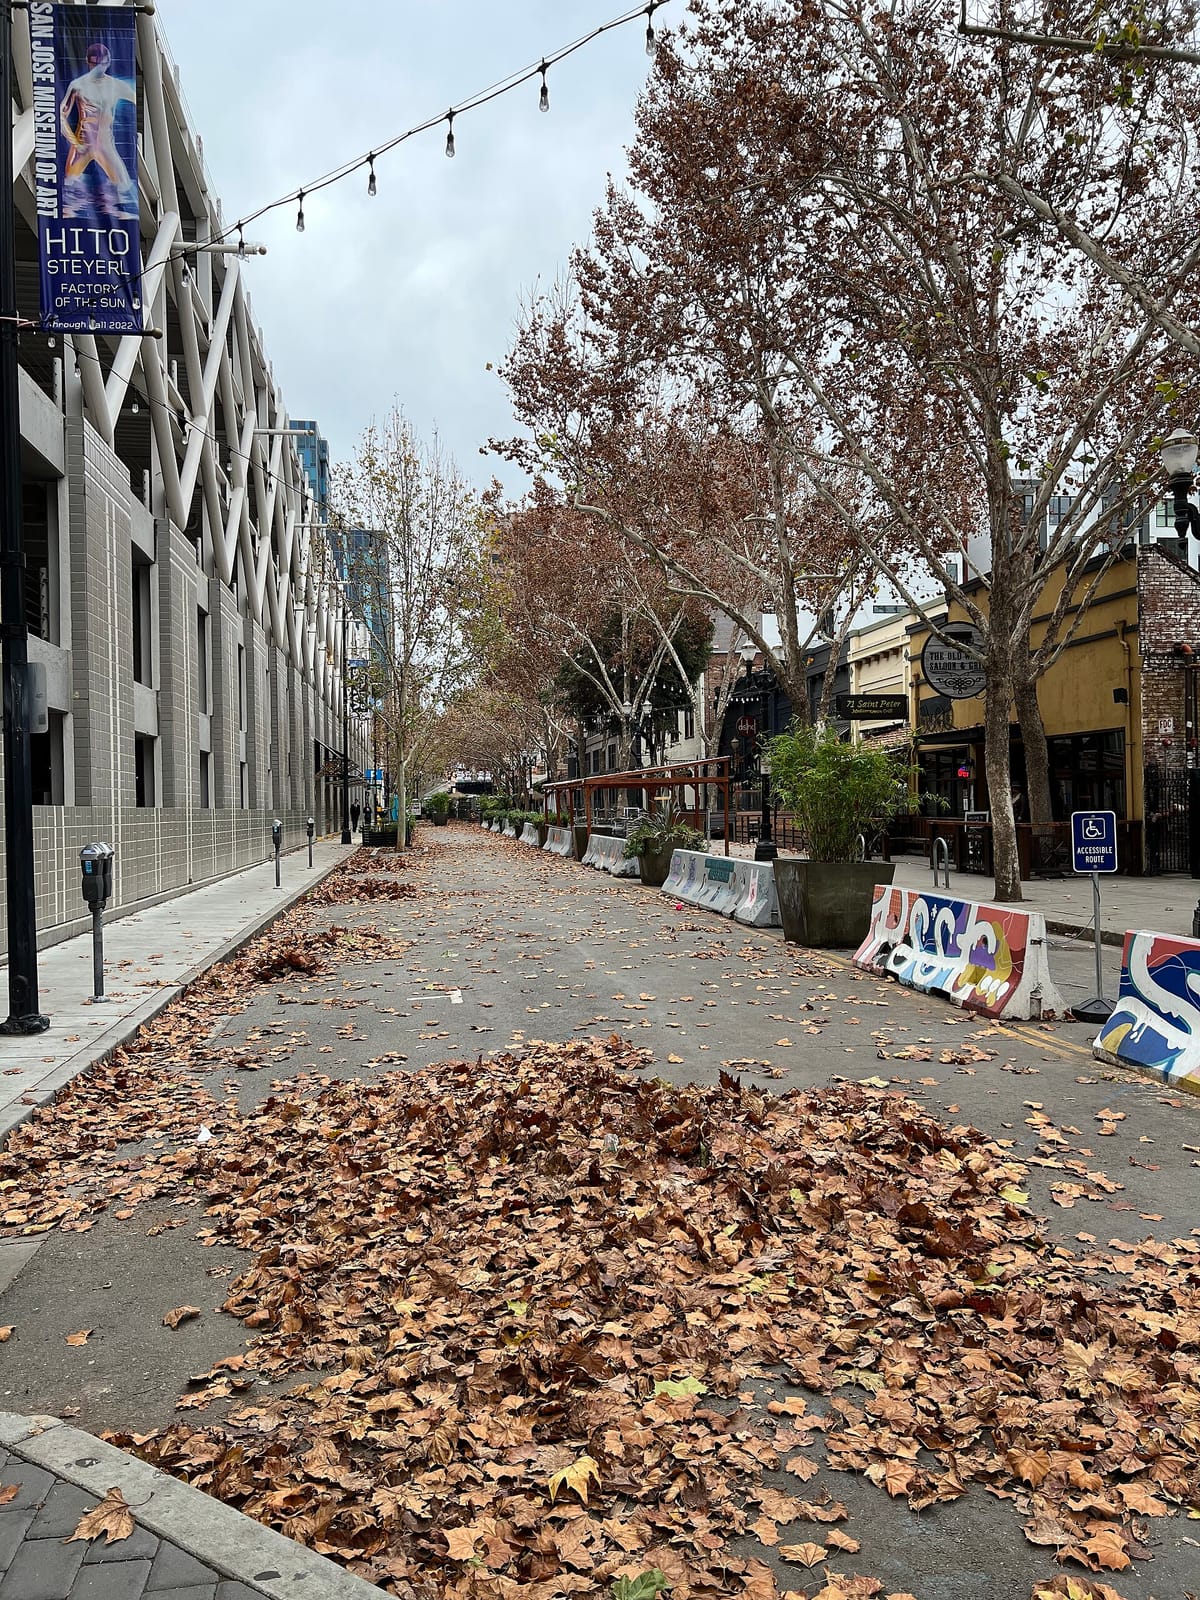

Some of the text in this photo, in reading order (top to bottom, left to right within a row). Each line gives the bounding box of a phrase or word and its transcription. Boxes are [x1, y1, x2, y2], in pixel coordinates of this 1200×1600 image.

[30, 2, 59, 218] SAN JOSE MUSEUM OF ART
[45, 227, 129, 255] HITO
[47, 259, 130, 275] STEYERL
[60, 283, 119, 294] FACTORY
[55, 297, 71, 307] OF
[100, 297, 126, 308] SUN
[49, 321, 87, 331] hrough
[109, 321, 134, 330] 2022
[929, 652, 944, 661] THE
[947, 652, 963, 661] OLD
[929, 661, 957, 671] SALOON
[960, 661, 966, 671] &
[846, 700, 901, 708] 71 Saint Peter
[1077, 846, 1113, 855] ACCESSIBLE
[1085, 855, 1105, 864] ROUTE
